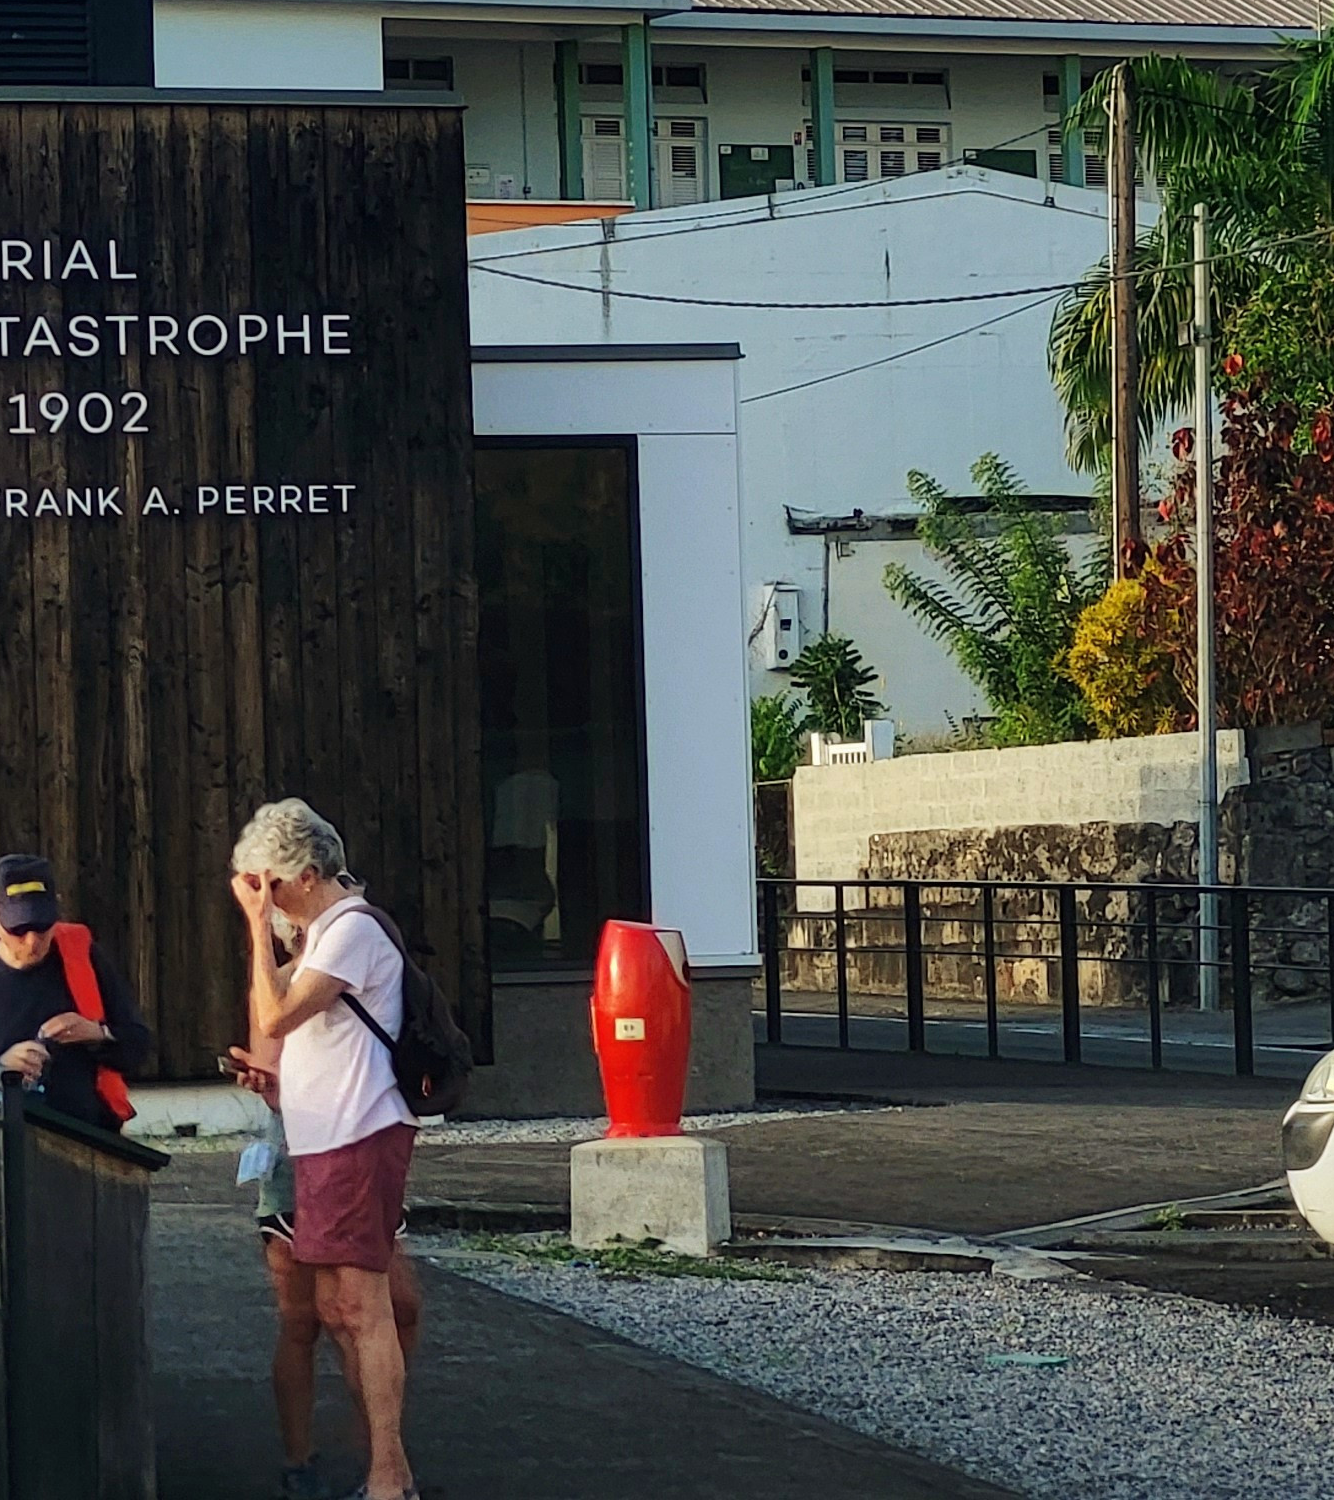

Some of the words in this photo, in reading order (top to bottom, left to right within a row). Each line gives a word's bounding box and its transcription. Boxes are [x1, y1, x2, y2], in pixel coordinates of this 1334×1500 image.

[8, 392, 149, 434] 1902
[142, 487, 179, 515] A.
[198, 485, 357, 515] PERRET
